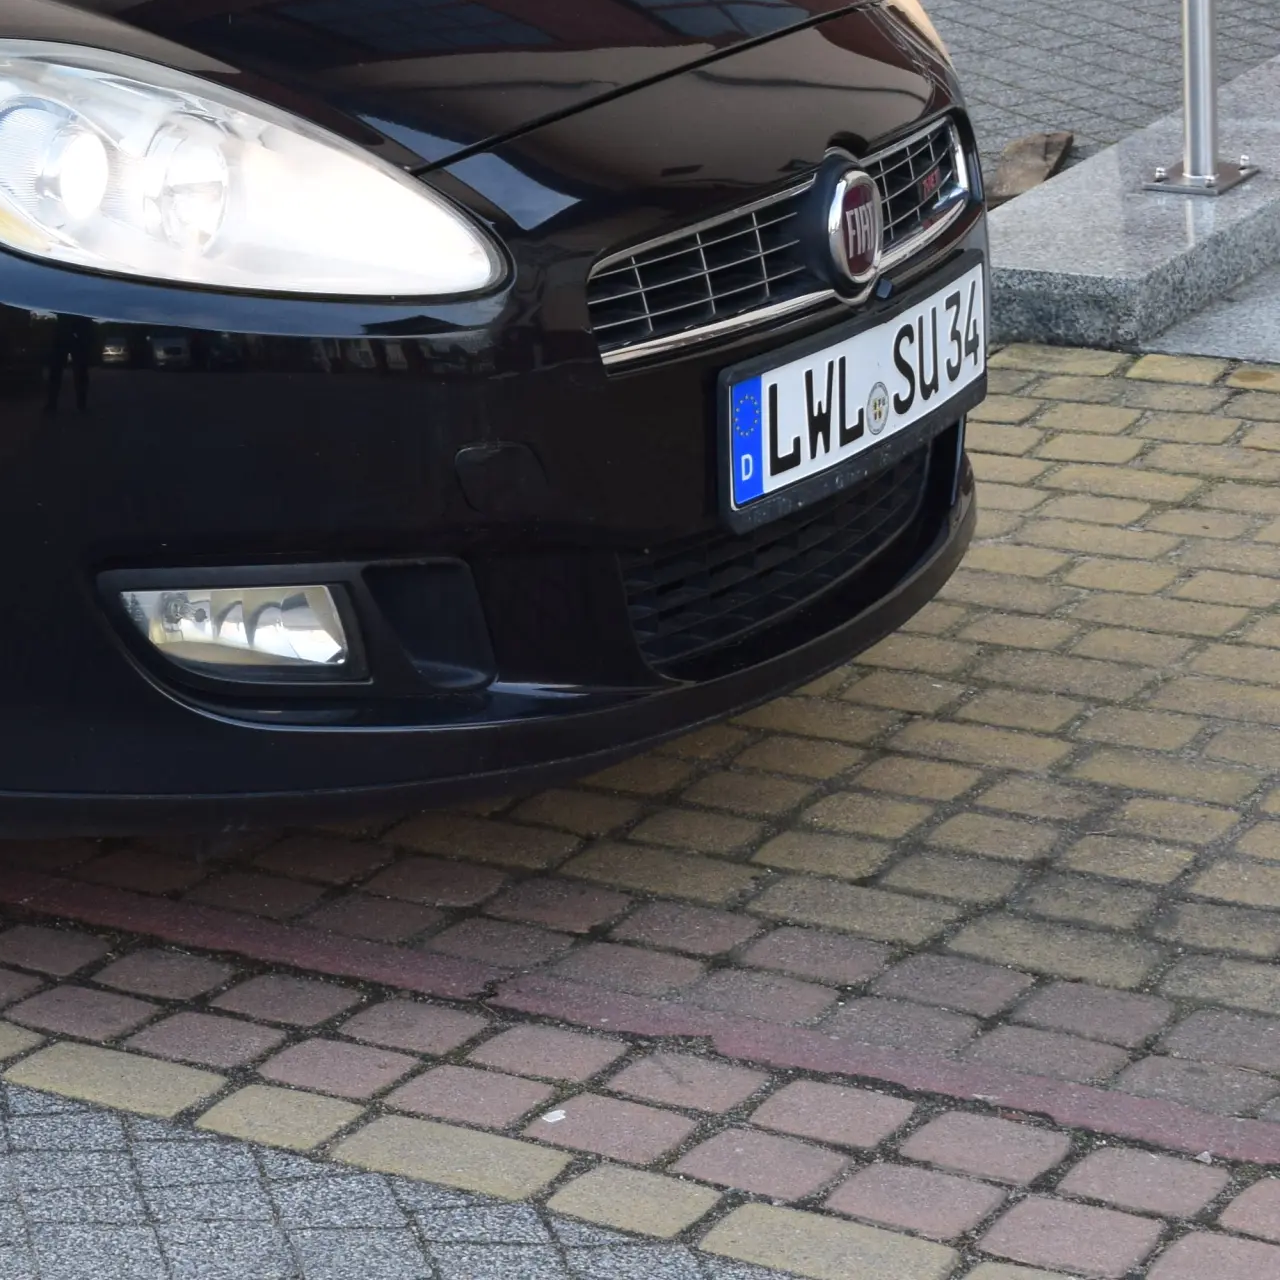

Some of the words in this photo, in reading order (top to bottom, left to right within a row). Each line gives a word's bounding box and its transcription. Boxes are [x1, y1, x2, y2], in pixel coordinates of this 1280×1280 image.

[845, 200, 874, 259] FIAT
[768, 355, 865, 477] LWL
[892, 307, 939, 415] SU
[944, 281, 980, 383] 34
[740, 454, 754, 482] D
